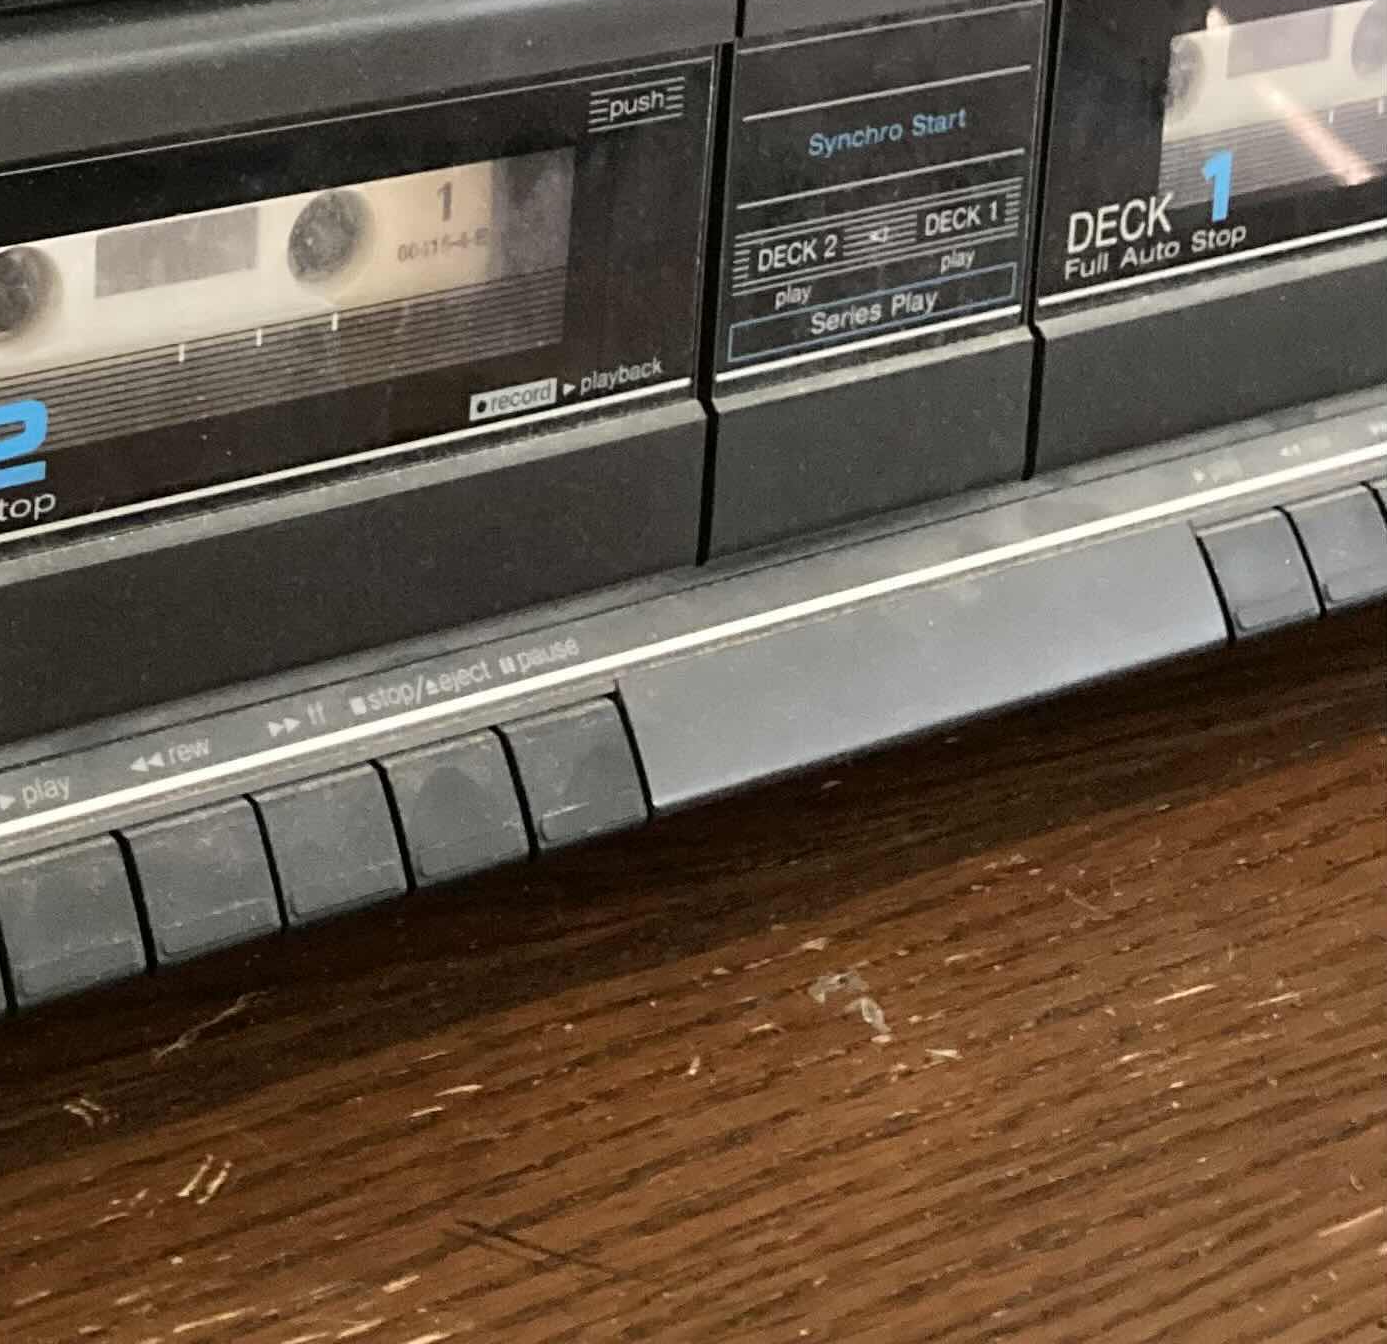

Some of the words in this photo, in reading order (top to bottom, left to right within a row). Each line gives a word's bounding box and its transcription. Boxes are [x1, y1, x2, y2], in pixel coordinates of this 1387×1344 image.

[609, 91, 665, 122] push
[808, 120, 903, 158] Synchro
[912, 108, 966, 137] Start
[436, 181, 452, 222] 1
[925, 204, 981, 237] DECK
[988, 200, 999, 221] 1
[1066, 191, 1174, 254] DECK
[1201, 148, 1233, 223] 1
[757, 238, 818, 273] DECK
[824, 234, 838, 258] 2
[940, 248, 976, 274] play
[1064, 255, 1109, 281] Full
[1120, 239, 1181, 270] Auto
[1191, 225, 1247, 254] Stop
[774, 283, 812, 310] play
[810, 304, 882, 335] Series
[891, 289, 939, 317] Play
[489, 383, 552, 408] record
[580, 357, 662, 396] playback
[516, 637, 580, 672] pause
[167, 735, 210, 766] rew
[22, 773, 71, 809] play
